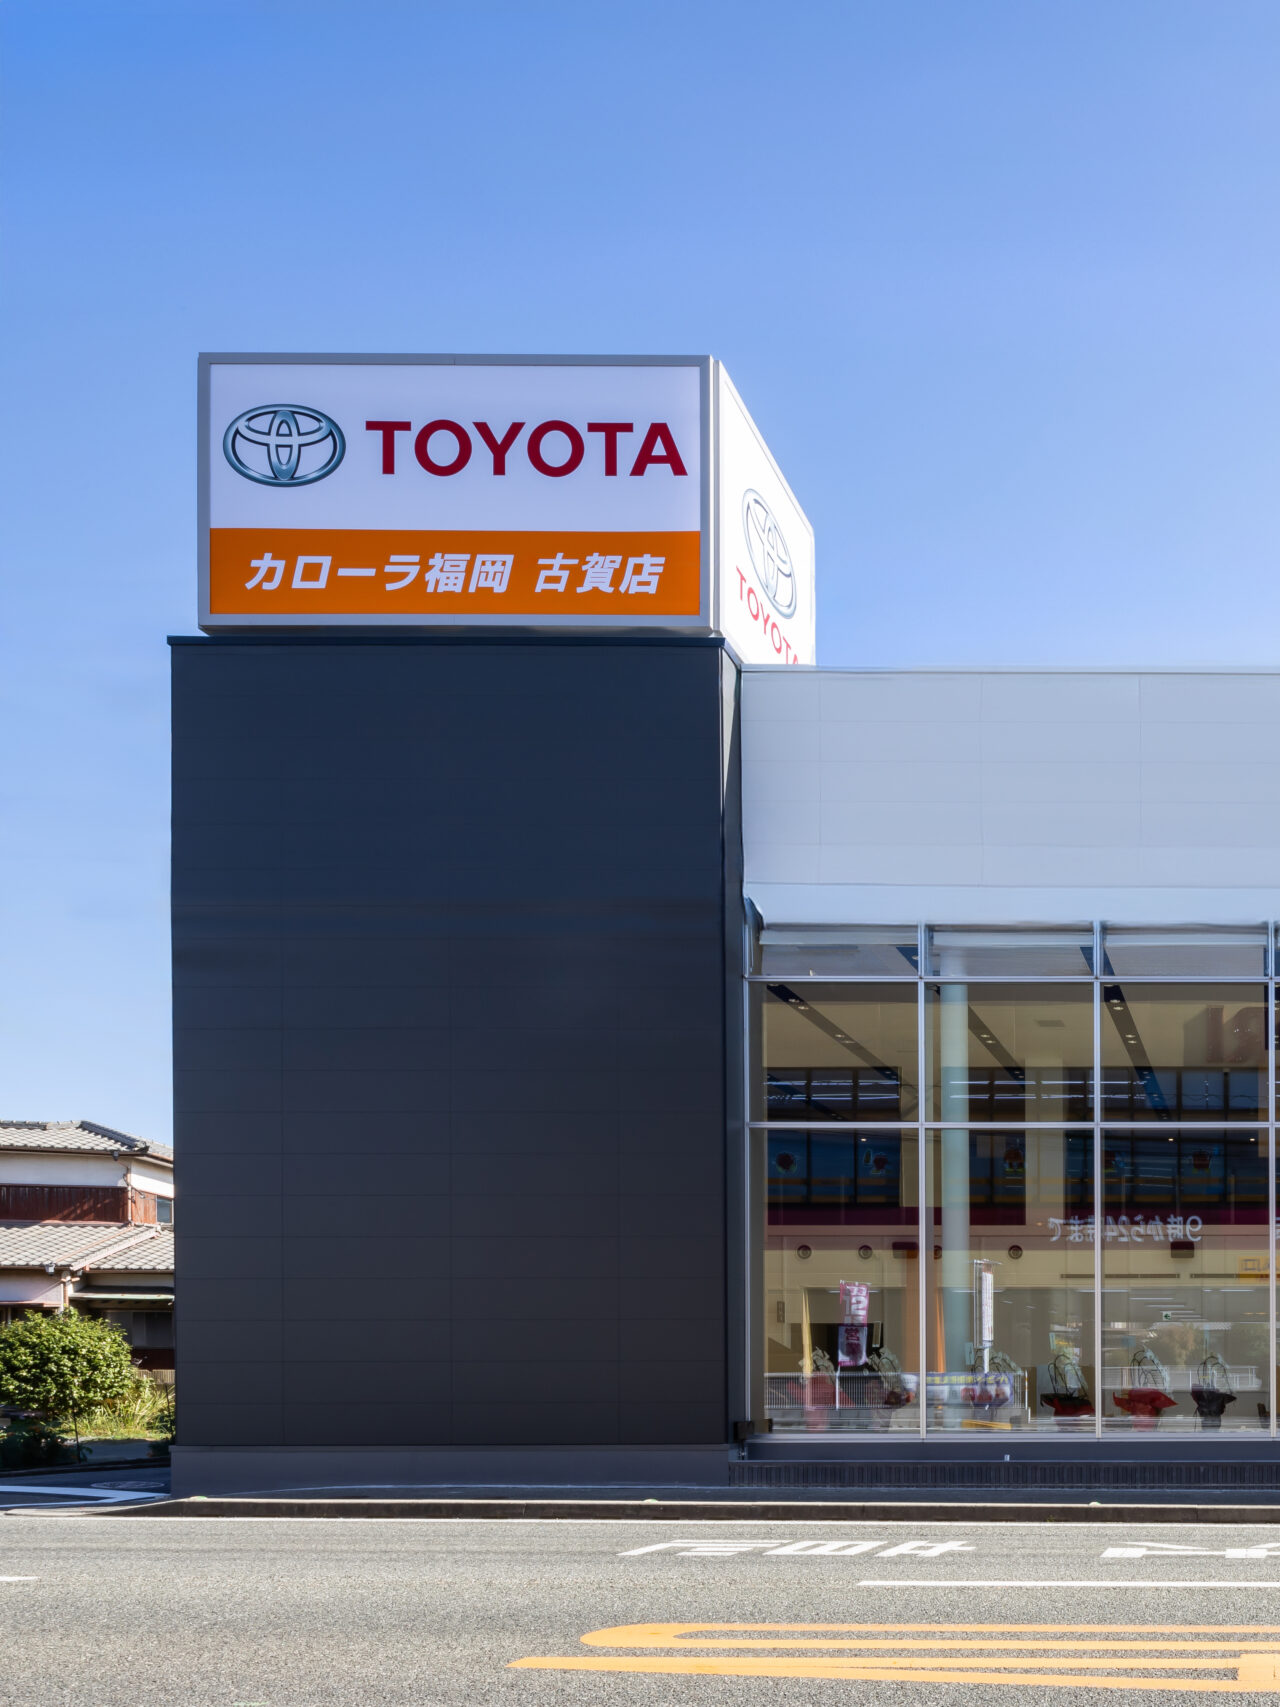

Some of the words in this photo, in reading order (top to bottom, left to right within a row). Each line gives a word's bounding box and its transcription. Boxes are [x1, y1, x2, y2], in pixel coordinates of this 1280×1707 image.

[366, 419, 688, 477] TOYOTA
[244, 551, 515, 594] カローラ福岡
[533, 551, 666, 595] 古賀店
